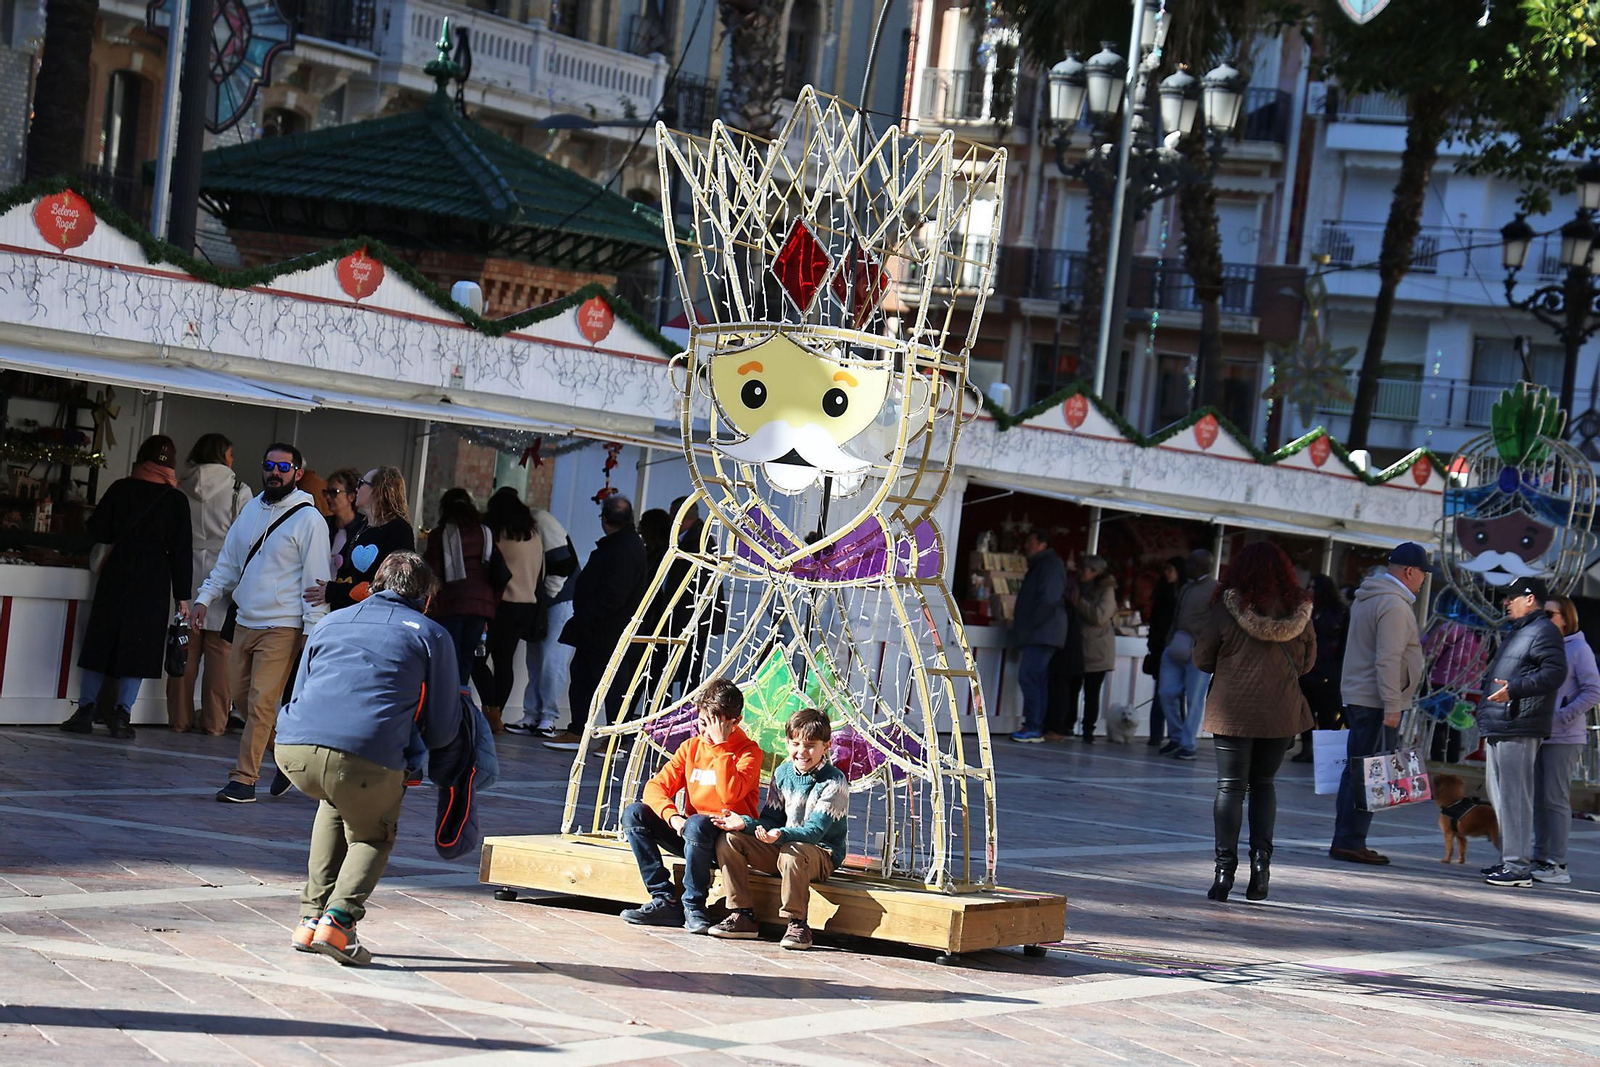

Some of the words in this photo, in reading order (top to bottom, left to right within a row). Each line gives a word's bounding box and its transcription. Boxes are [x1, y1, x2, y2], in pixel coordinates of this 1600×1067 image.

[51, 203, 80, 218] Belenes
[55, 216, 77, 233] Rogel
[350, 257, 372, 271] Belenes
